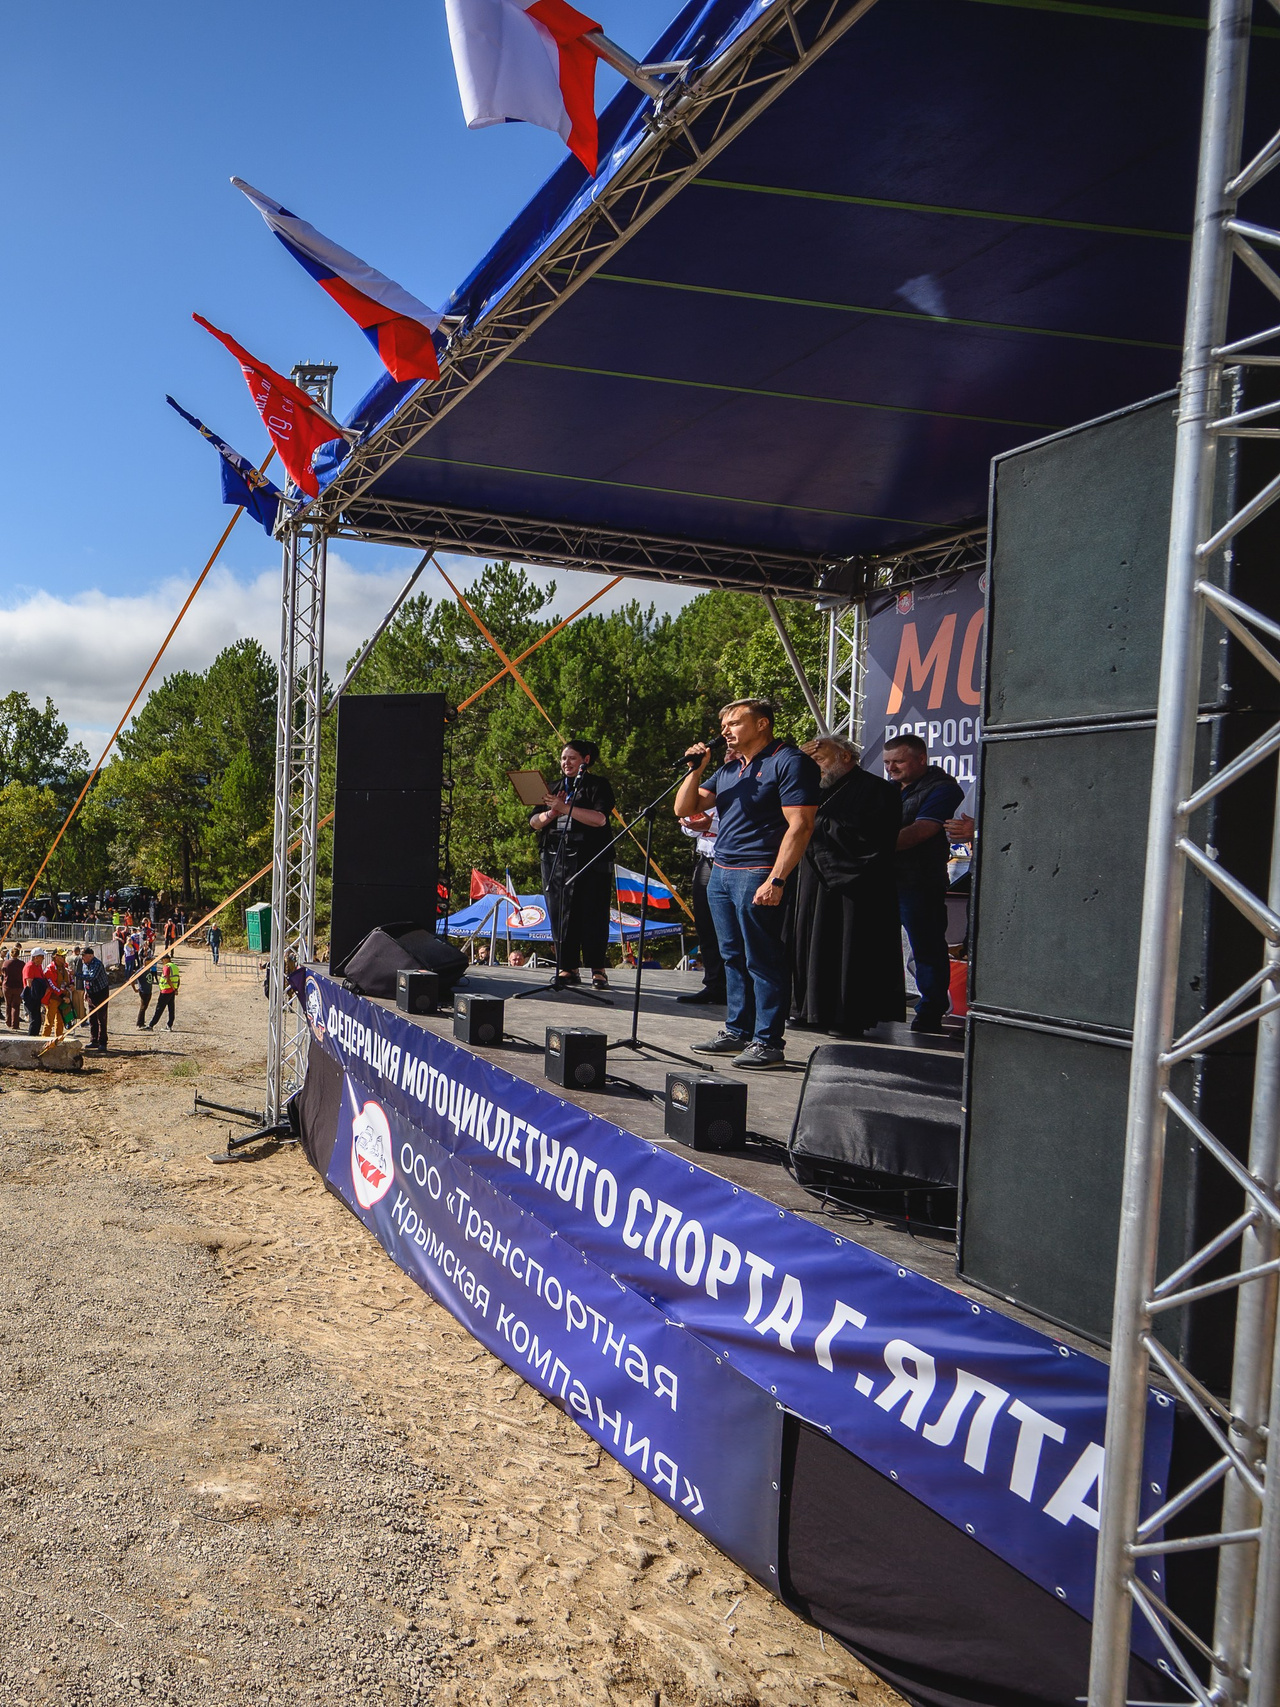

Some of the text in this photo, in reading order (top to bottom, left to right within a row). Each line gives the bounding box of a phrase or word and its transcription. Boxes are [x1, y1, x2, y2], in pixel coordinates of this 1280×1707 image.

[326, 1004, 401, 1085] ФЕДЕРАЦИЯ
[401, 1051, 617, 1228] МОТОЦИКЛЕТНОГО
[622, 1187, 804, 1353] СПОРТА
[400, 1143, 678, 1412] ООО «Транспортная
[391, 1189, 705, 1515] Крымская компания»
